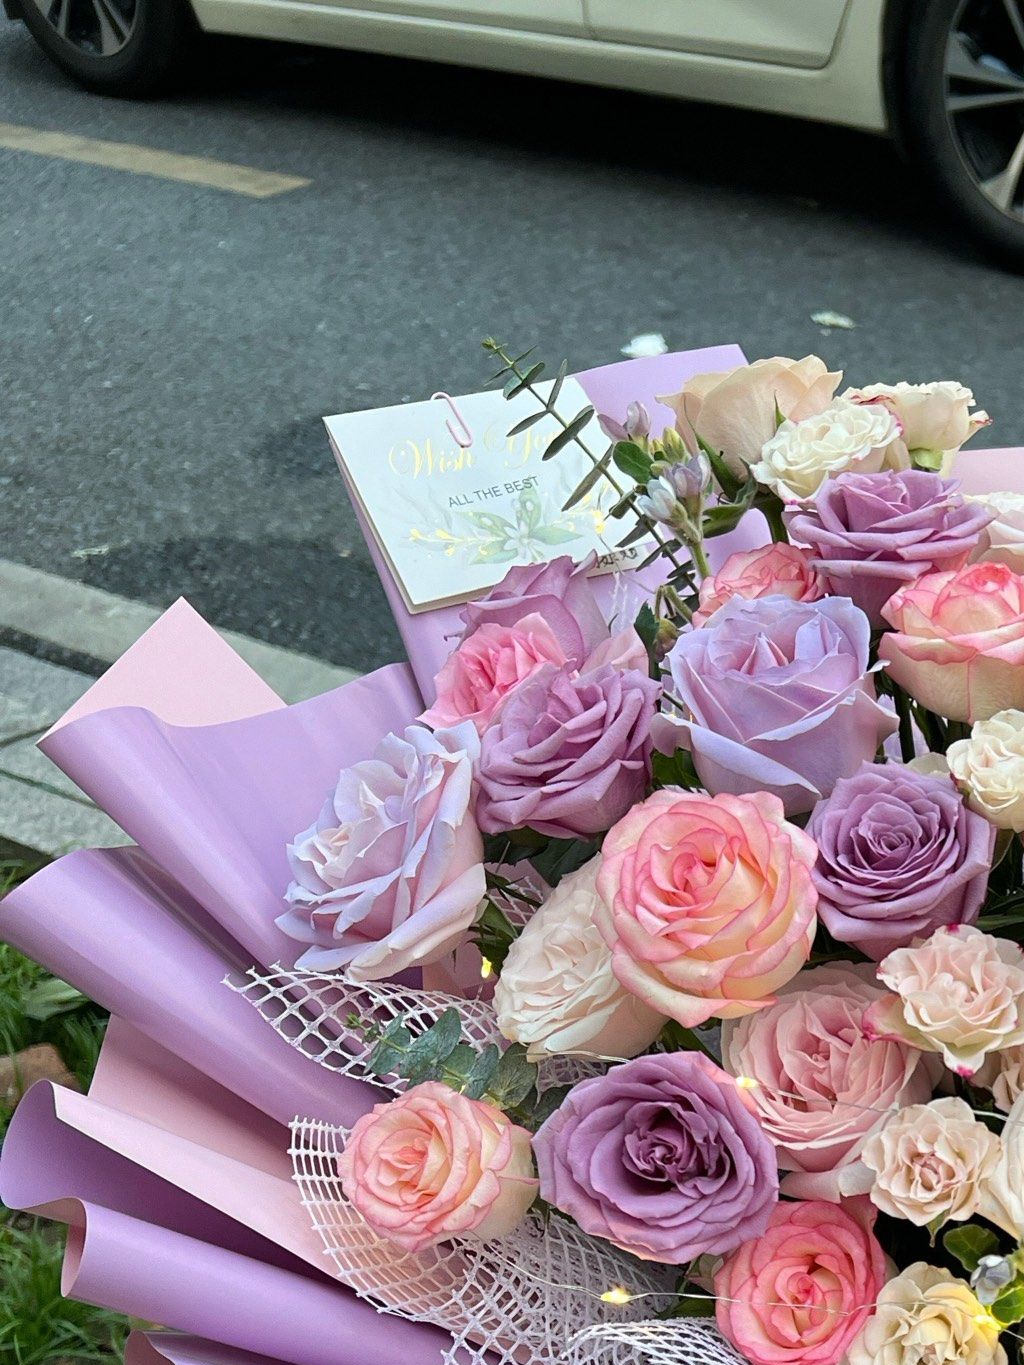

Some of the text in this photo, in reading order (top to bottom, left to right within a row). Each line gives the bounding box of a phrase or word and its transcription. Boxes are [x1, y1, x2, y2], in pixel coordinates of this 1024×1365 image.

[448, 475, 541, 508] ALL THE BEST
